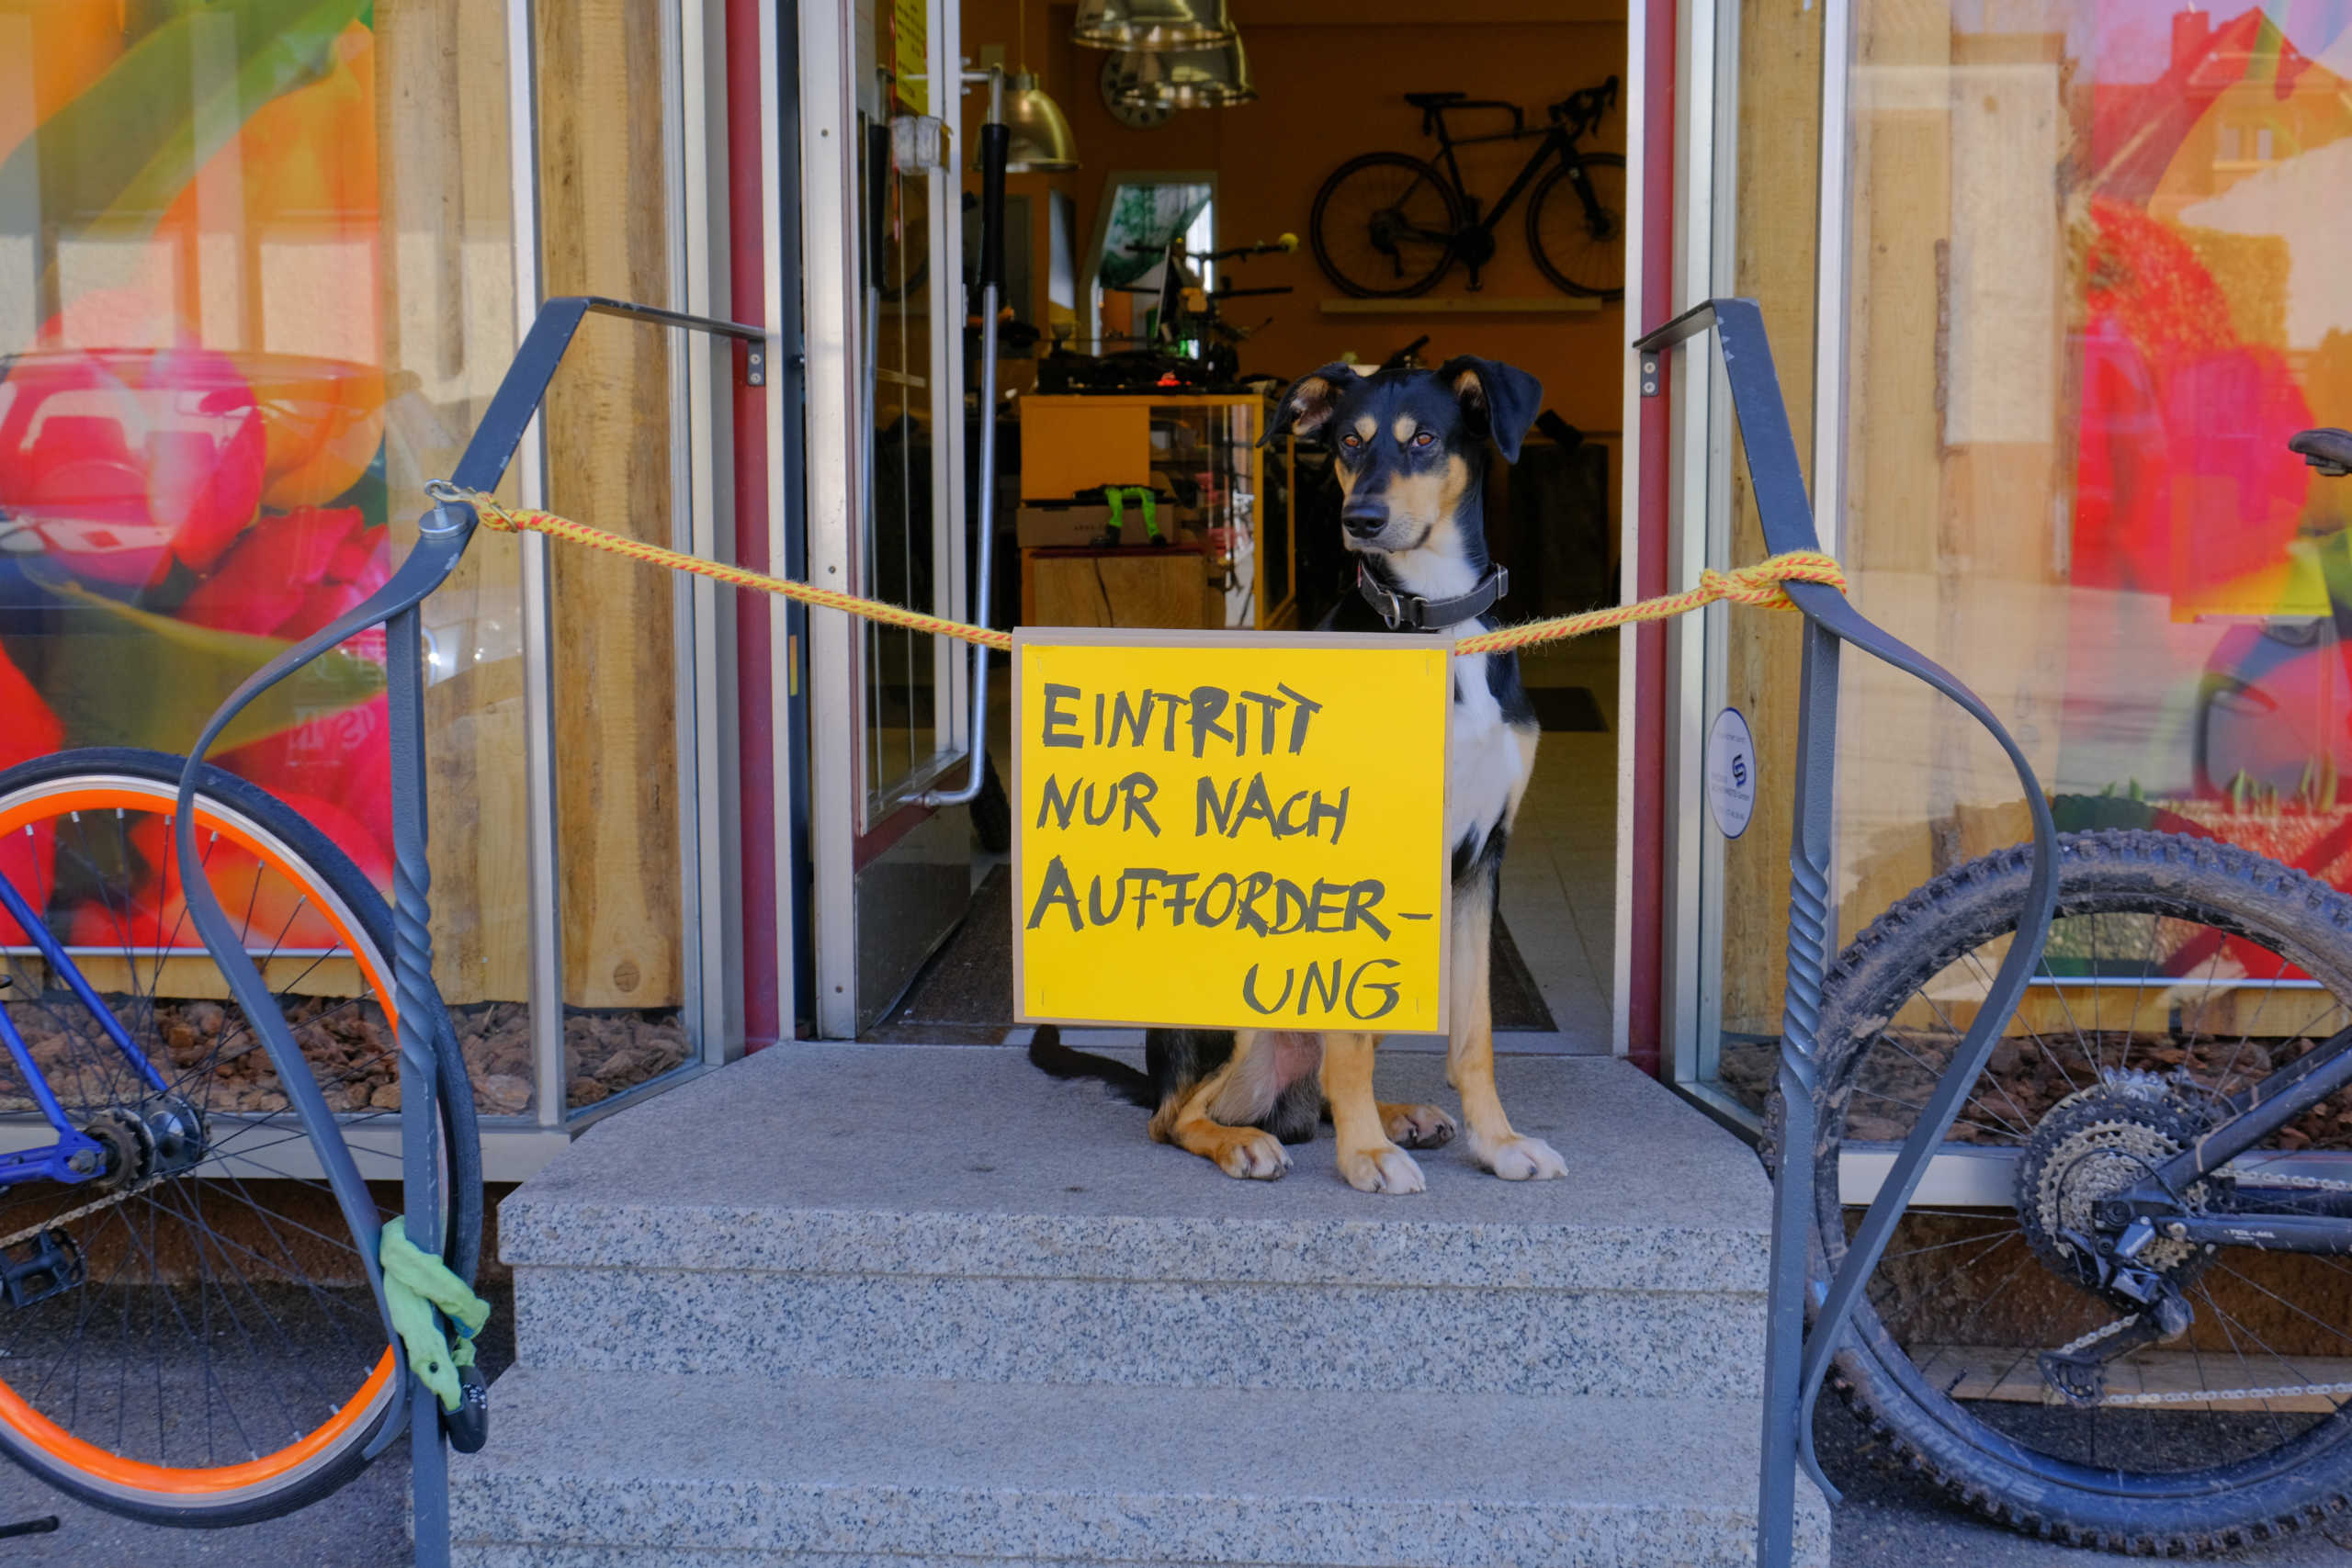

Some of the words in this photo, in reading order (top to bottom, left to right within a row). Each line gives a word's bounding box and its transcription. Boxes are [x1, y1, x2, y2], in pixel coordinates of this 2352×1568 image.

[1042, 682, 1323, 759] EINTRITT
[1035, 772, 1161, 838] NUR
[1194, 772, 1351, 845] NACH
[1242, 959, 1401, 1021] UNG
